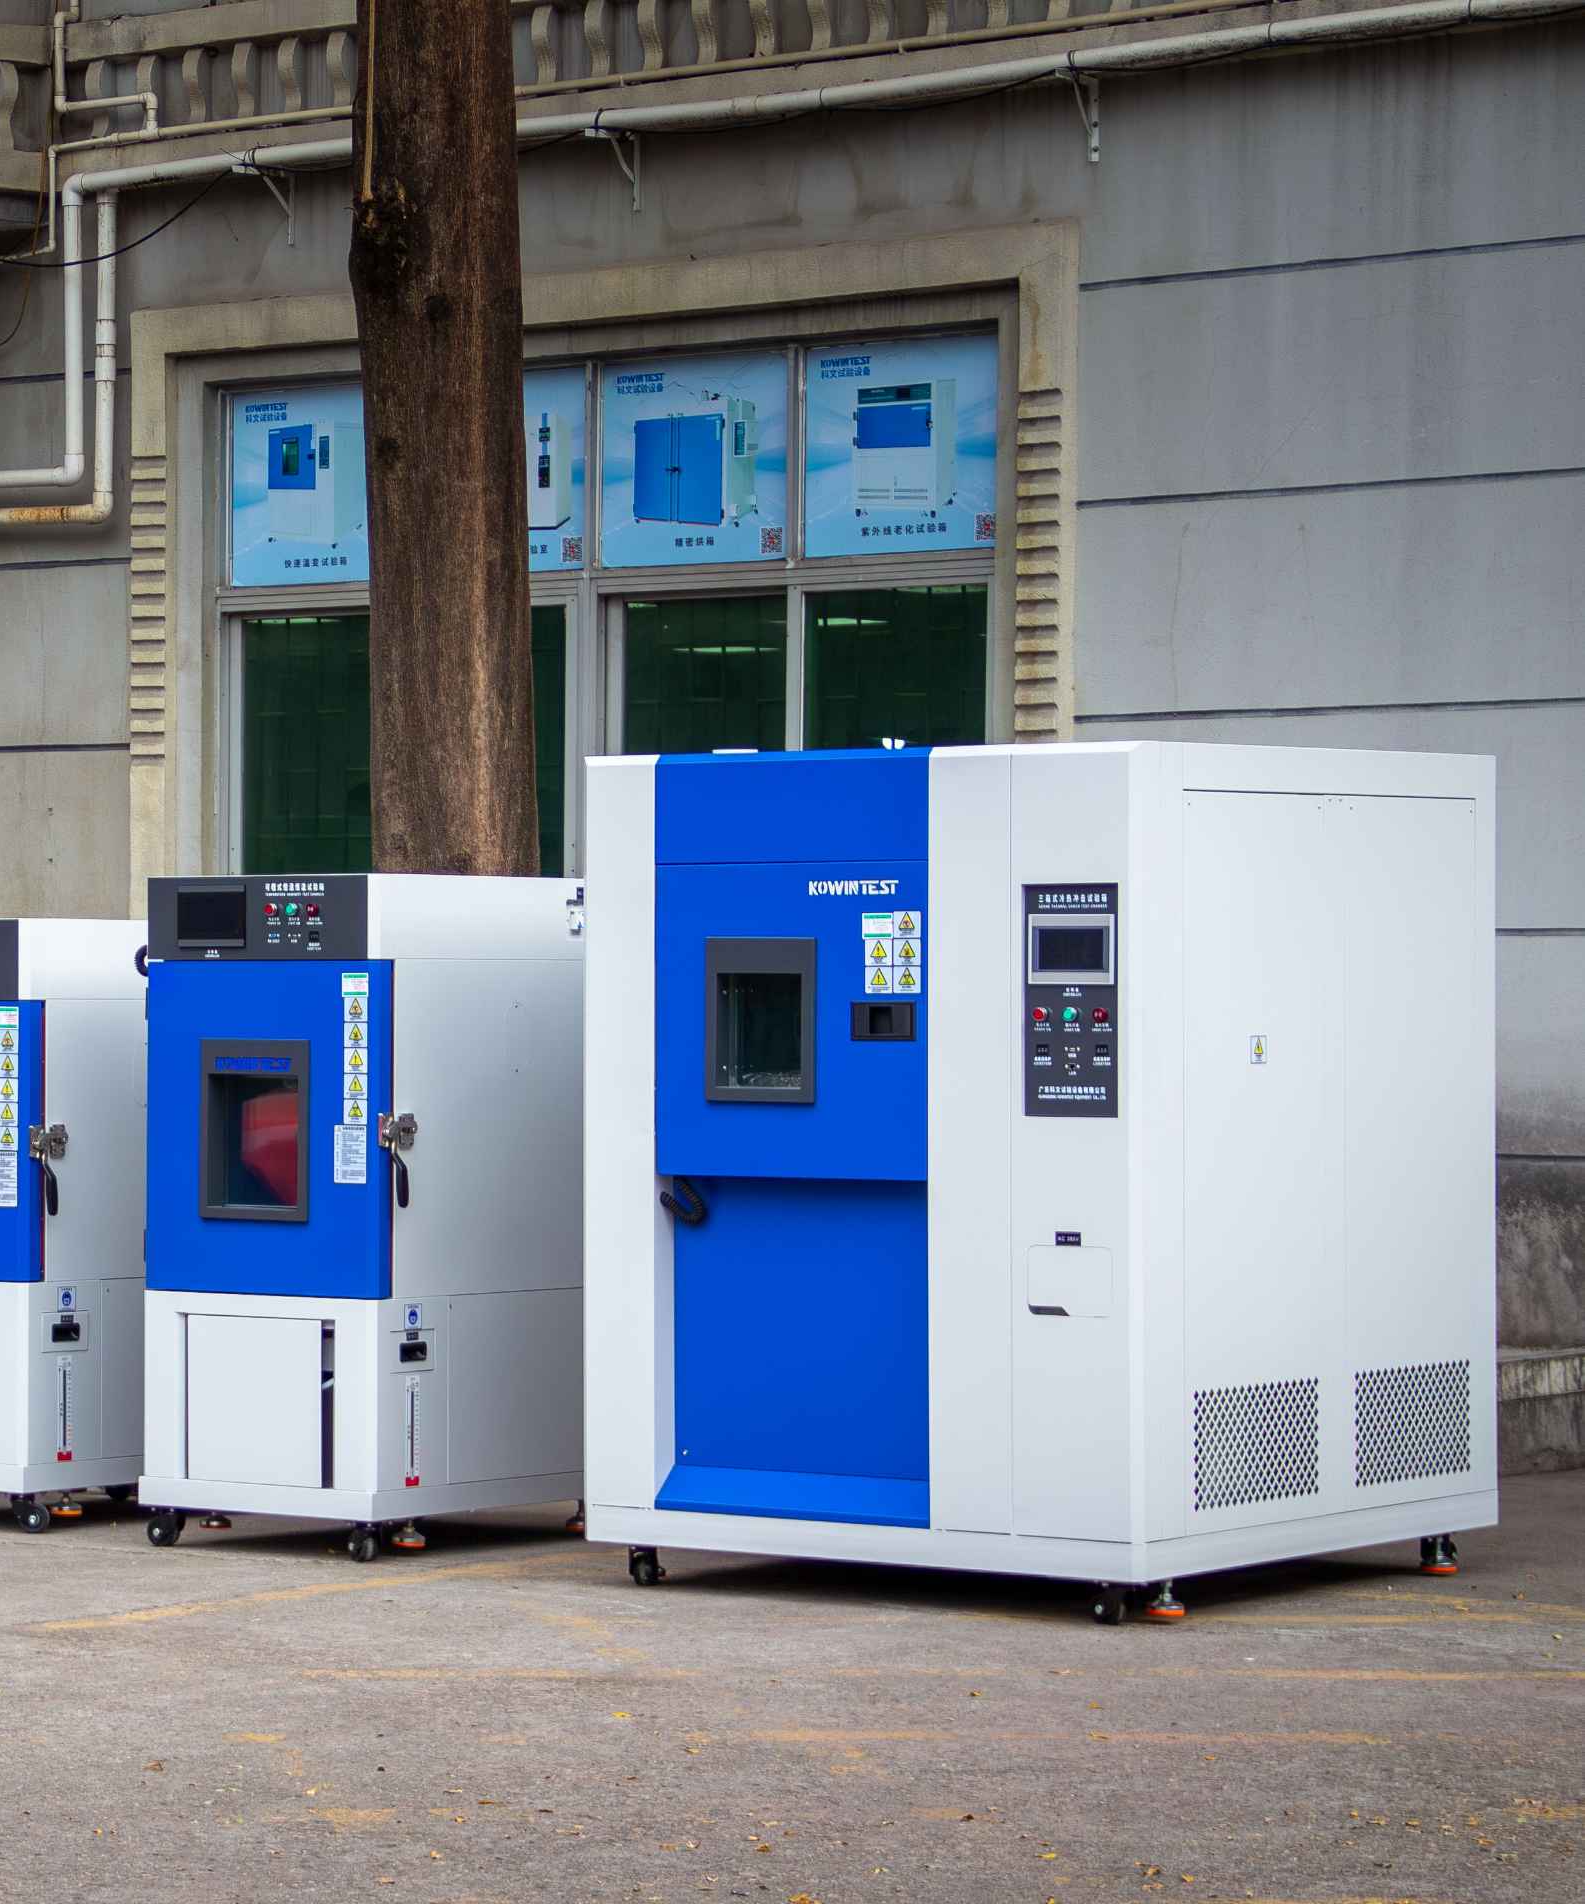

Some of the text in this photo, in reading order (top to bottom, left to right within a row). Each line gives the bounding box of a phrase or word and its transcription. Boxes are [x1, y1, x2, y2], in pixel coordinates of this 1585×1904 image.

[861, 522, 947, 537] 紫外线老化试验箱
[808, 880, 899, 896] KOWINTEST
